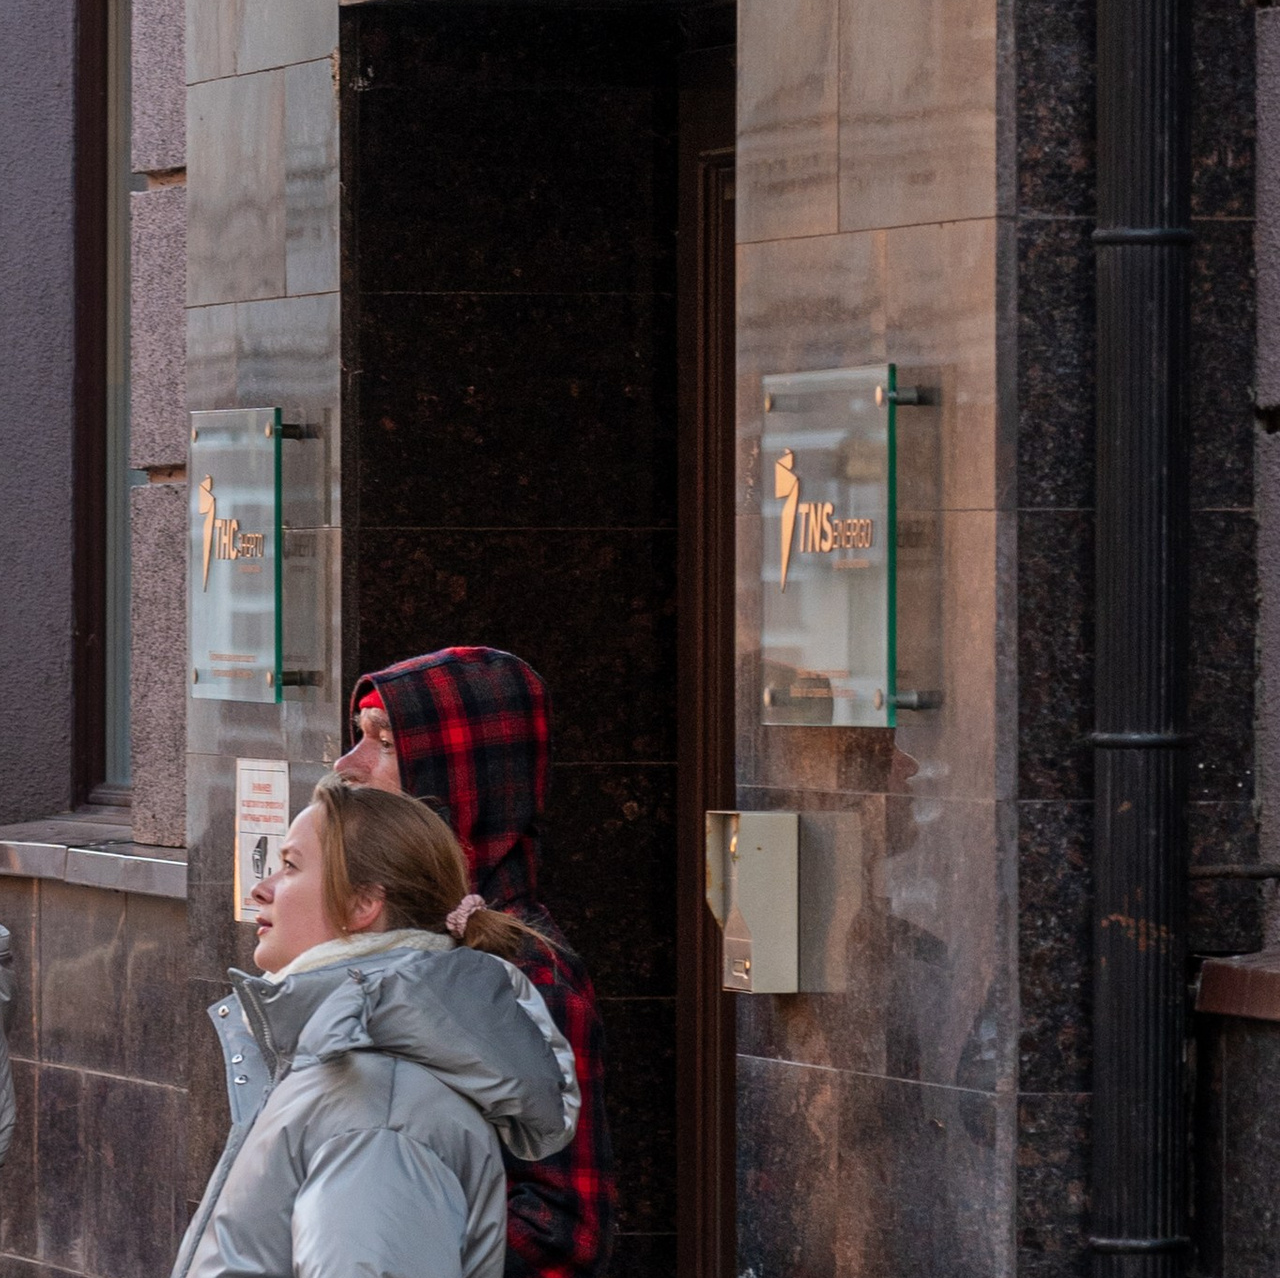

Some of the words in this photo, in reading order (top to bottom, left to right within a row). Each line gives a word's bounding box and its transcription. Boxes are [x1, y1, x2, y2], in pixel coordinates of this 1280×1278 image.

[215, 518, 239, 560] ТНС
[799, 502, 834, 553] TNS
[832, 518, 872, 549] ENERGO
